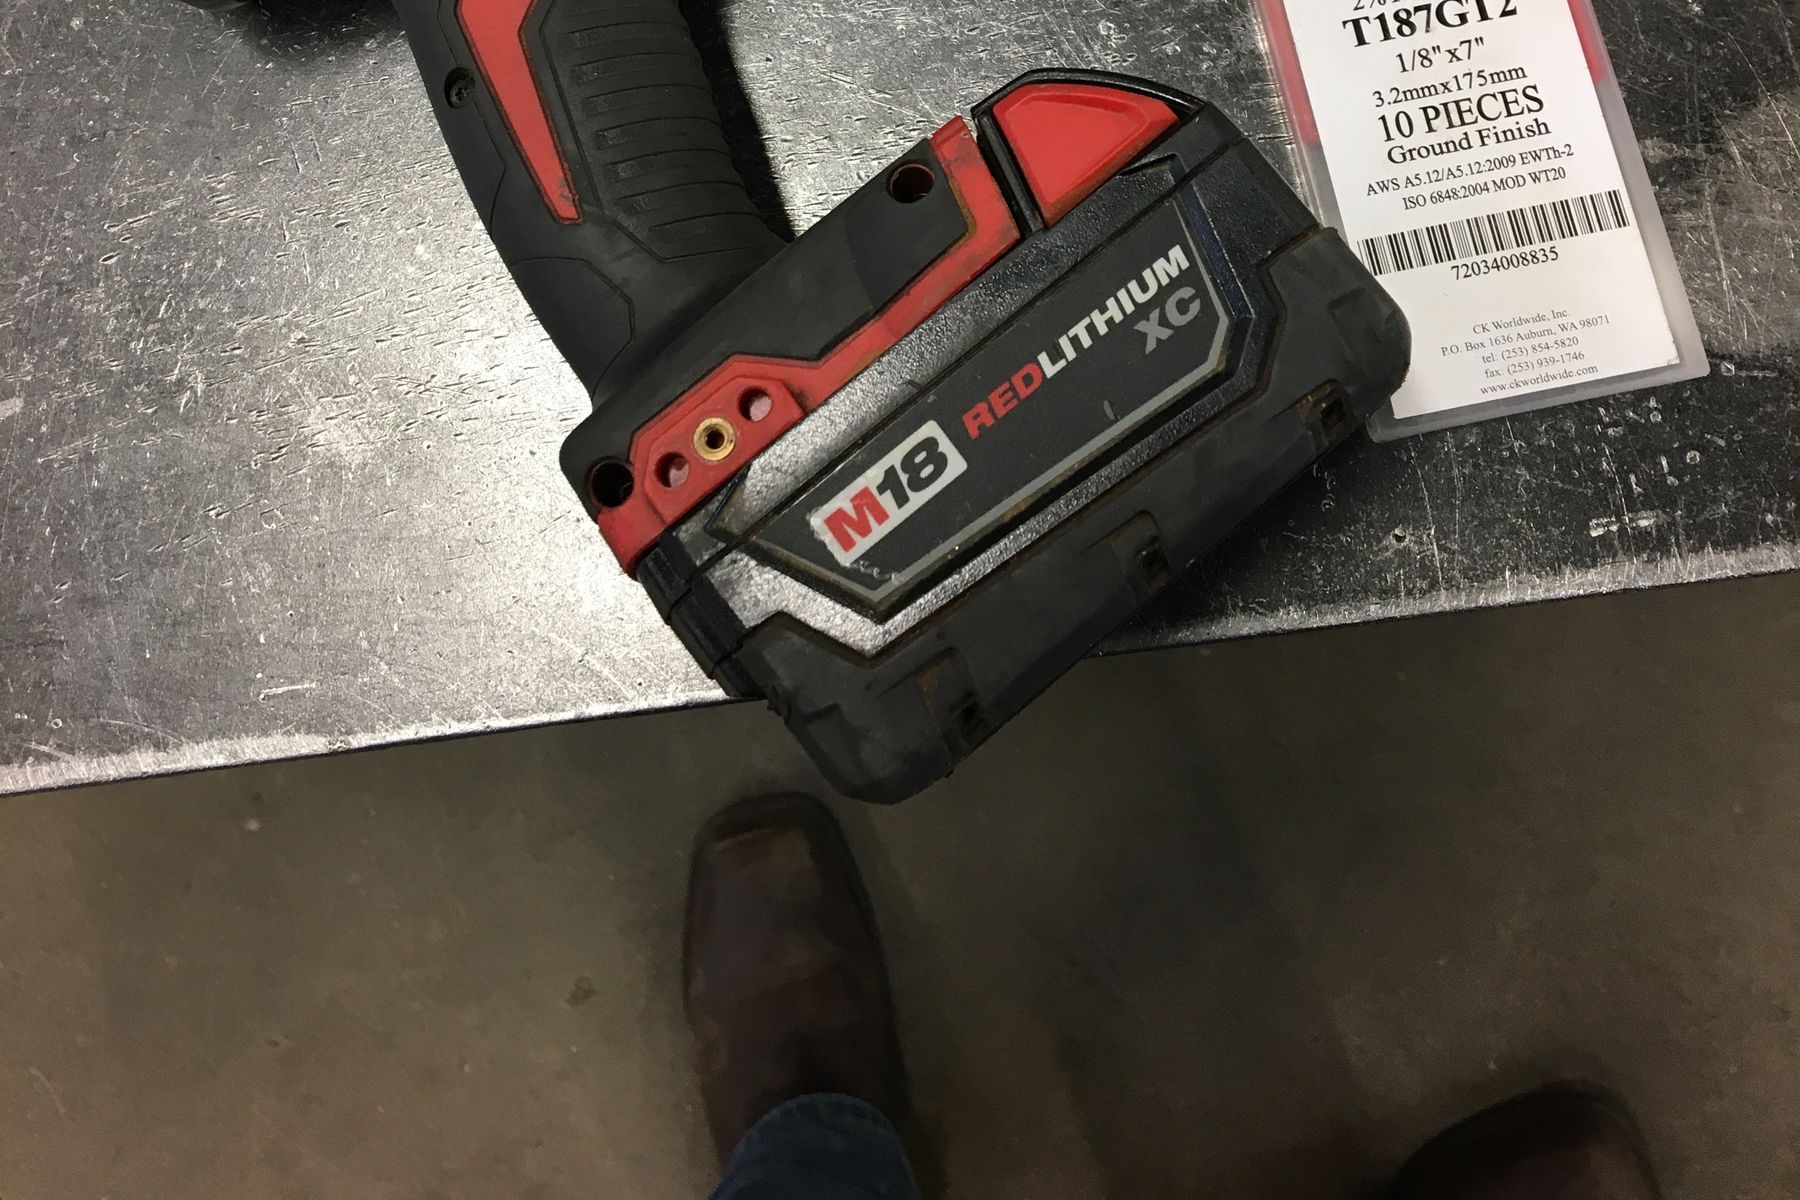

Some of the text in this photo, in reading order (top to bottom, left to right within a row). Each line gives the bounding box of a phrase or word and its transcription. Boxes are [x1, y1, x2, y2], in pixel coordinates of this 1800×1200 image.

[1372, 65, 1529, 107] 3.2mmx175mm
[1377, 84, 1546, 142] 10 PIECES
[1387, 118, 1552, 165] Ground Finish
[1366, 178, 1400, 196] AWS
[1519, 143, 1575, 166] EWTh-2
[1402, 166, 1567, 210] ISO 6848:2004 MOD WT20
[1450, 245, 1560, 280] 72034008835
[1133, 286, 1201, 355] XC
[1440, 314, 1610, 357] P.O. Box 1636 Auburn, WA 98071
[1472, 309, 1571, 335] CK Worldwide, Inc.
[1484, 351, 1585, 380] fax: (253) 939-1746
[1501, 345, 1529, 362] (253)
[1531, 336, 1579, 354] 854-5820
[823, 244, 1190, 553] M18 REDLITHIUM
[1480, 364, 1599, 396] www.ckworldwide.com
